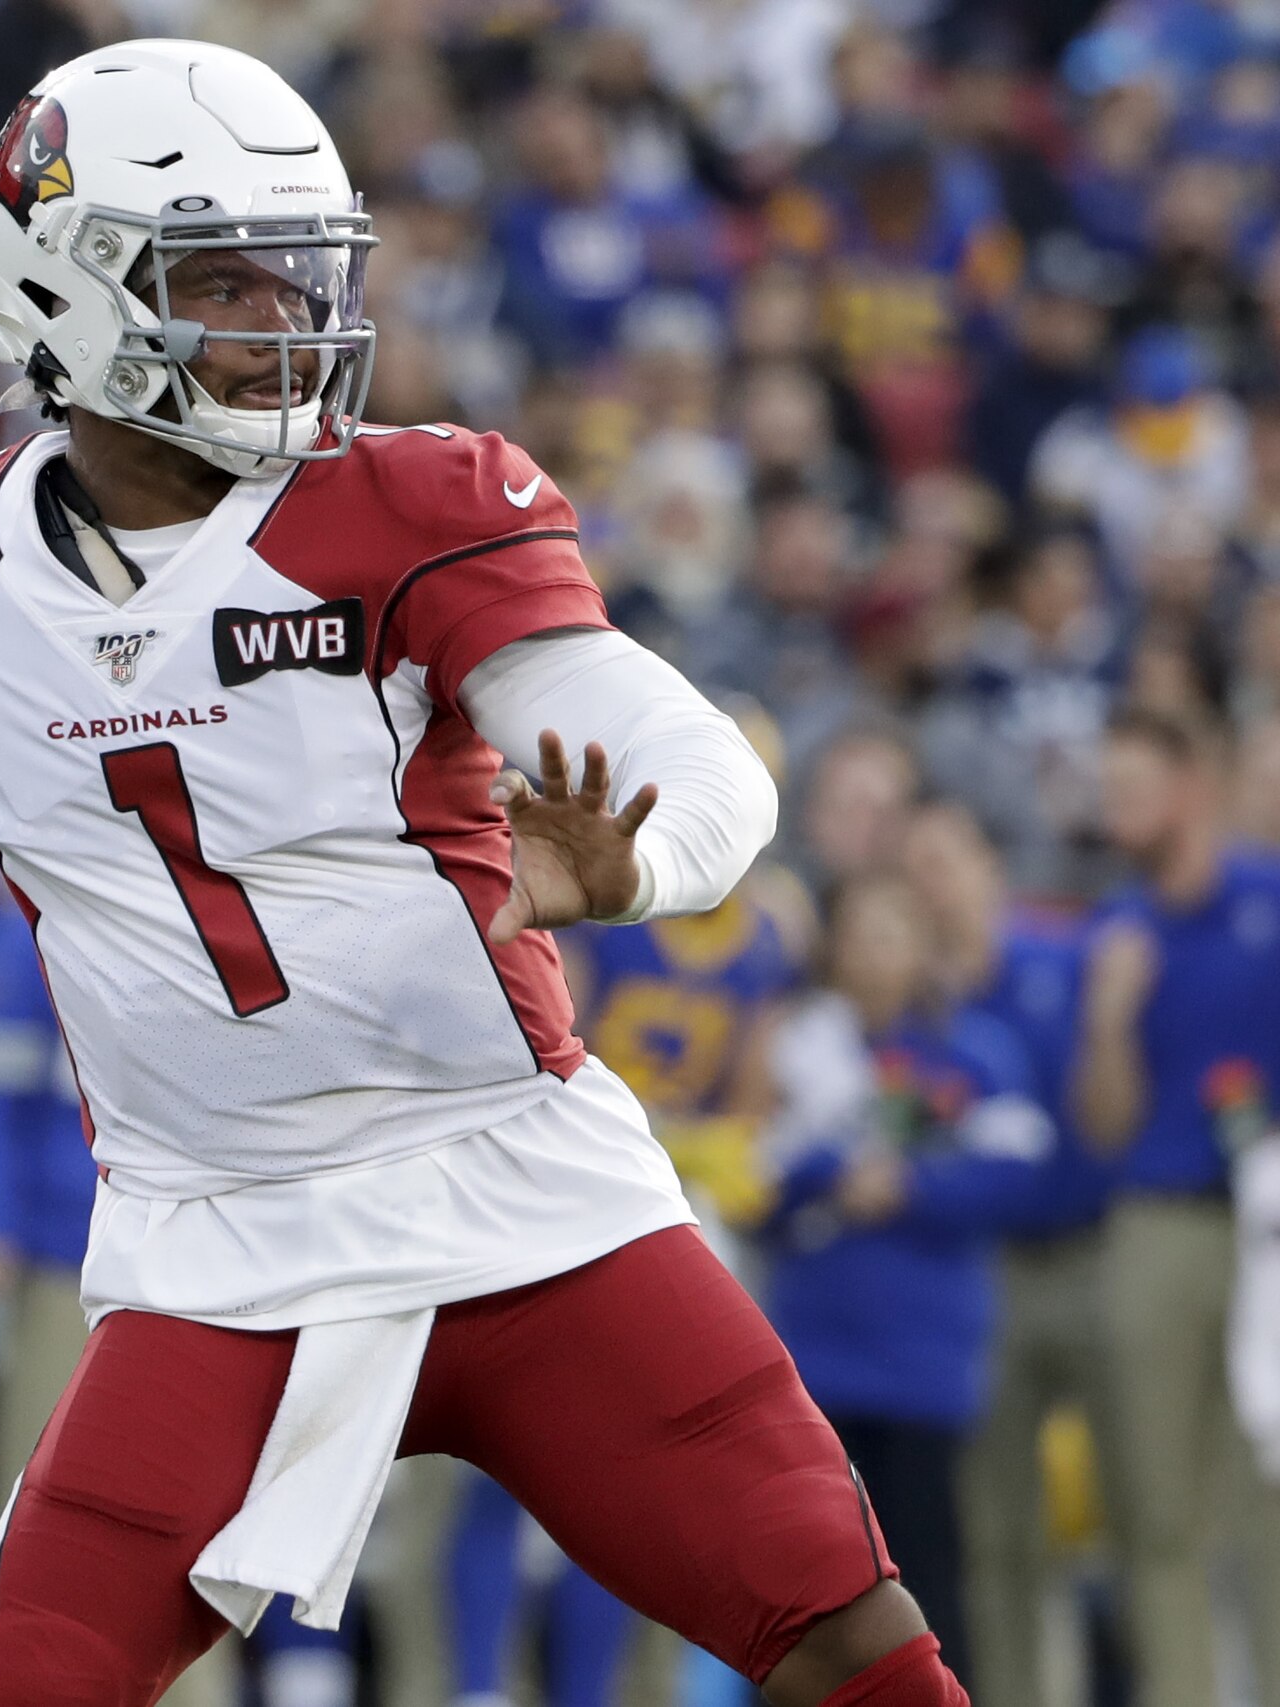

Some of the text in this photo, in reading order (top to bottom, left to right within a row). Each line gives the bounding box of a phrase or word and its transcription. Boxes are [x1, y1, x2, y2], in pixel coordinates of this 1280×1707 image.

[271, 185, 330, 194] CARDINALS
[231, 617, 346, 665] WVB
[113, 665, 131, 678] NFL
[46, 704, 228, 740] CARDINALS
[100, 741, 290, 1018] 1
